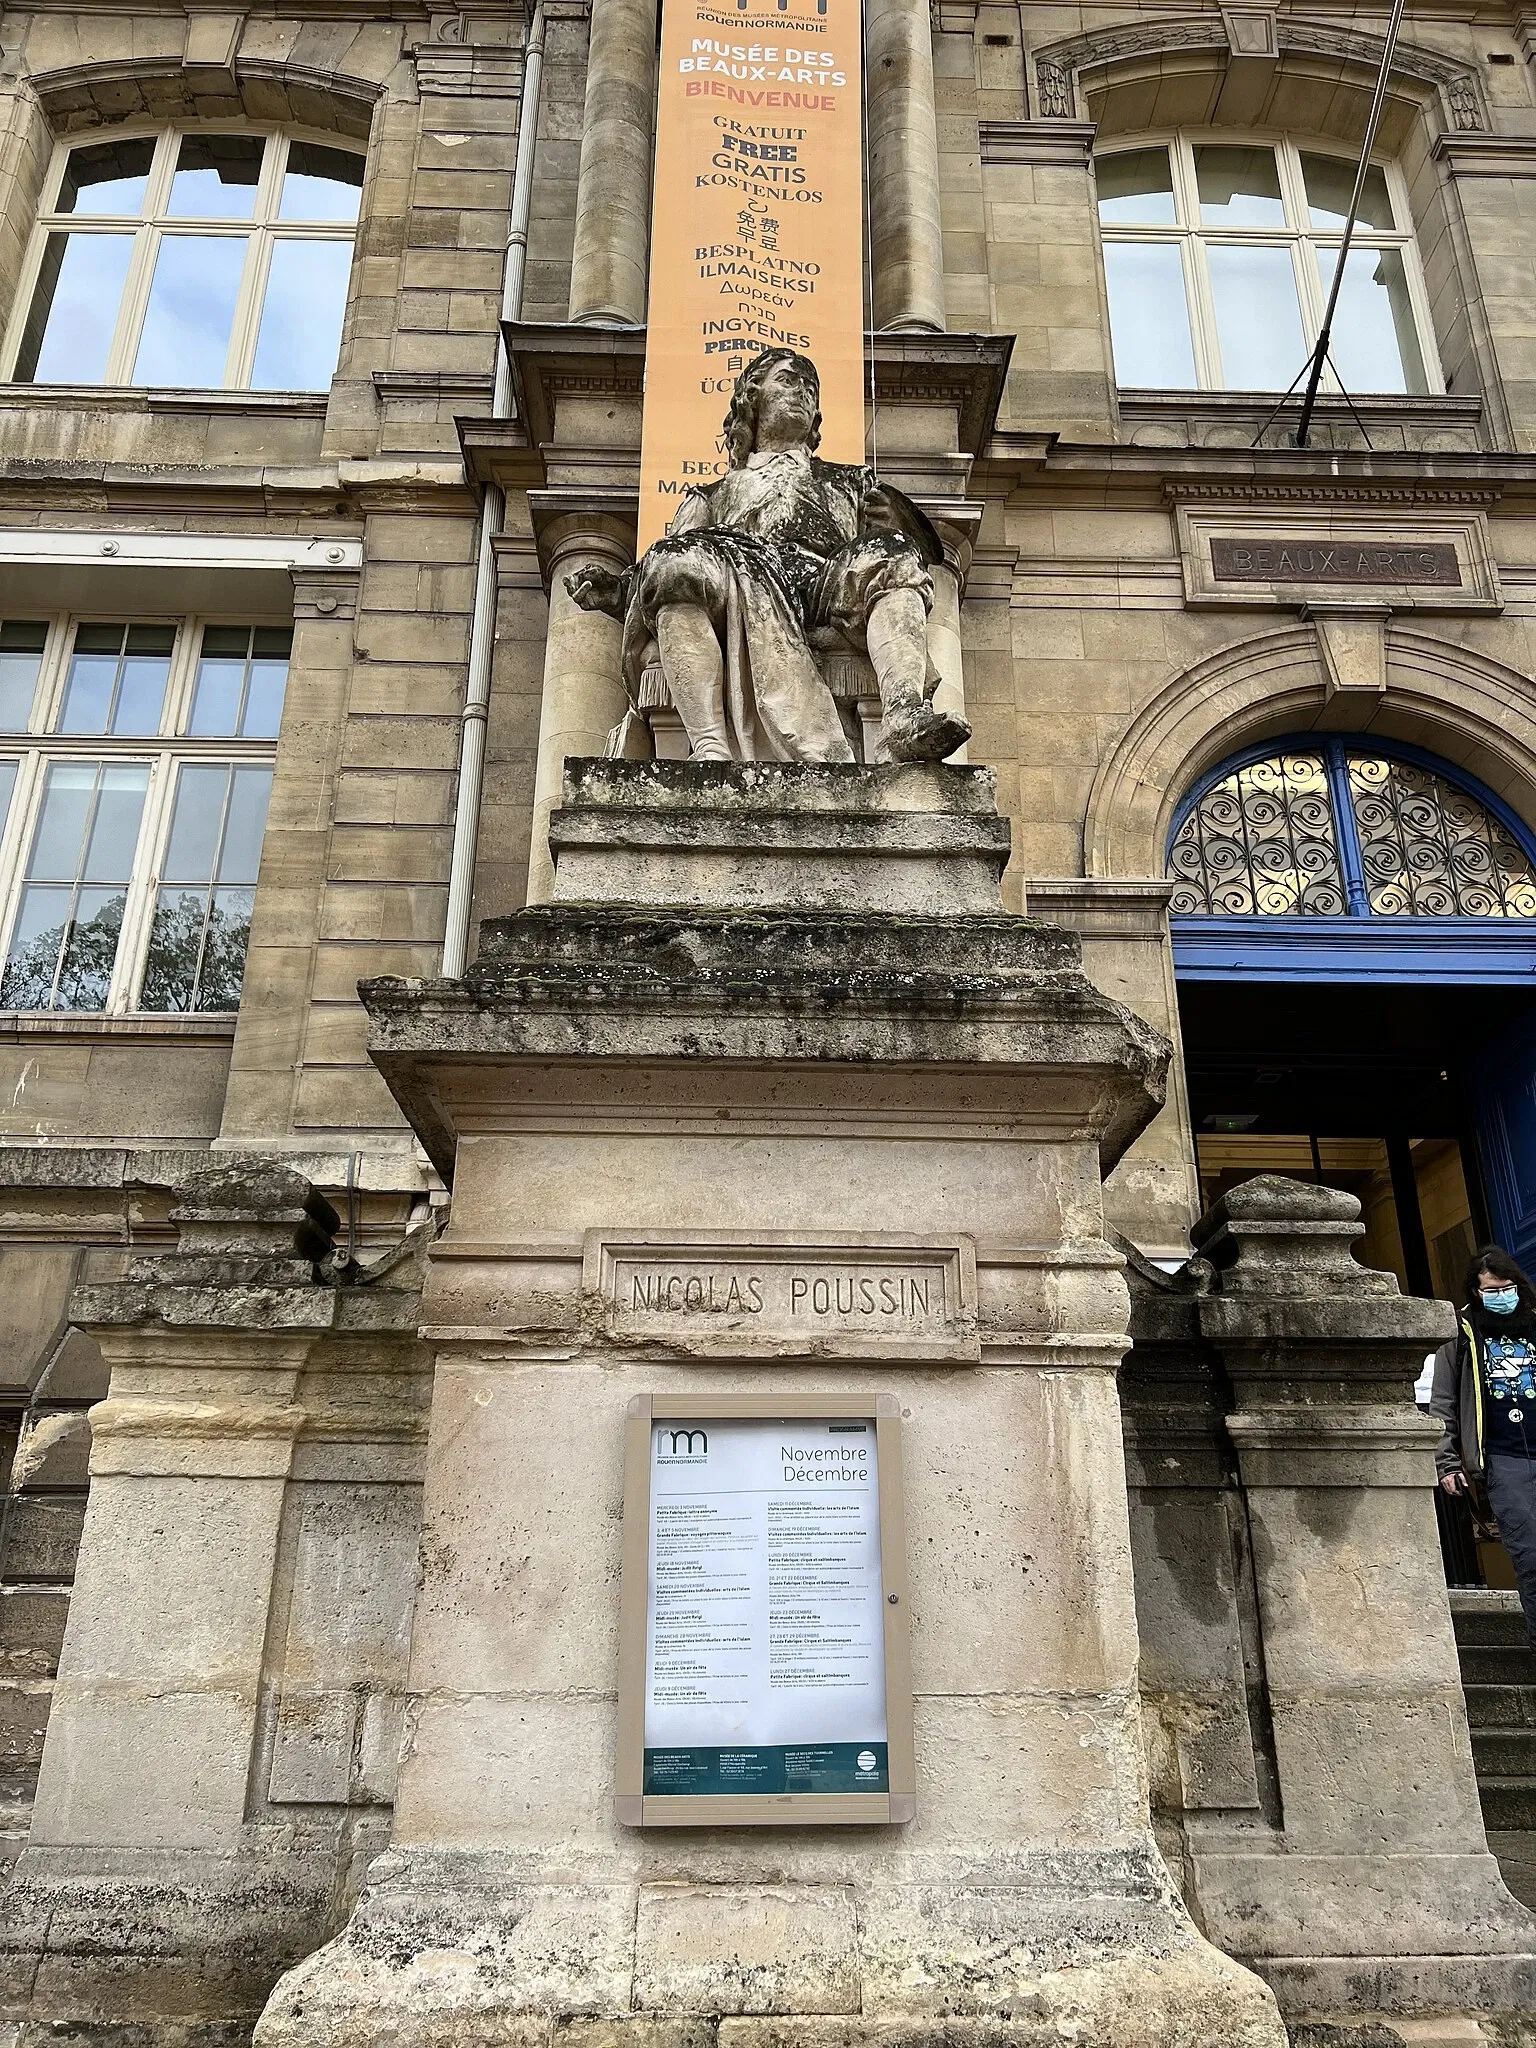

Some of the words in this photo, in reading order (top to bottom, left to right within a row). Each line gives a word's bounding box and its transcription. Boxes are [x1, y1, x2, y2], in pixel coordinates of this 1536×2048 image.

[697, 6, 727, 16] RÉUNION
[771, 13, 827, 23] MÉTROPOLITAINS
[692, 38, 779, 62] MUSÉE
[785, 48, 835, 67] DES
[679, 57, 847, 87] BEAUX-ARTS
[685, 81, 836, 112] BIENVENUE
[713, 115, 807, 140] GRATUIT
[722, 134, 797, 162] FREE
[712, 153, 806, 184] GRATIS
[695, 173, 822, 203] KOSTENLOS
[694, 247, 820, 276] BESPLATNO
[700, 262, 814, 293] ILMAISEKSI
[720, 281, 794, 308] Δωρεάν
[702, 318, 810, 348] INGYENES
[1235, 549, 1437, 576] BEAUX-ARTS
[632, 1275, 763, 1314] NICOLAS
[791, 1277, 930, 1316] POUSSIN
[781, 1446, 867, 1461] Novembre
[784, 1466, 868, 1482] Décembre
